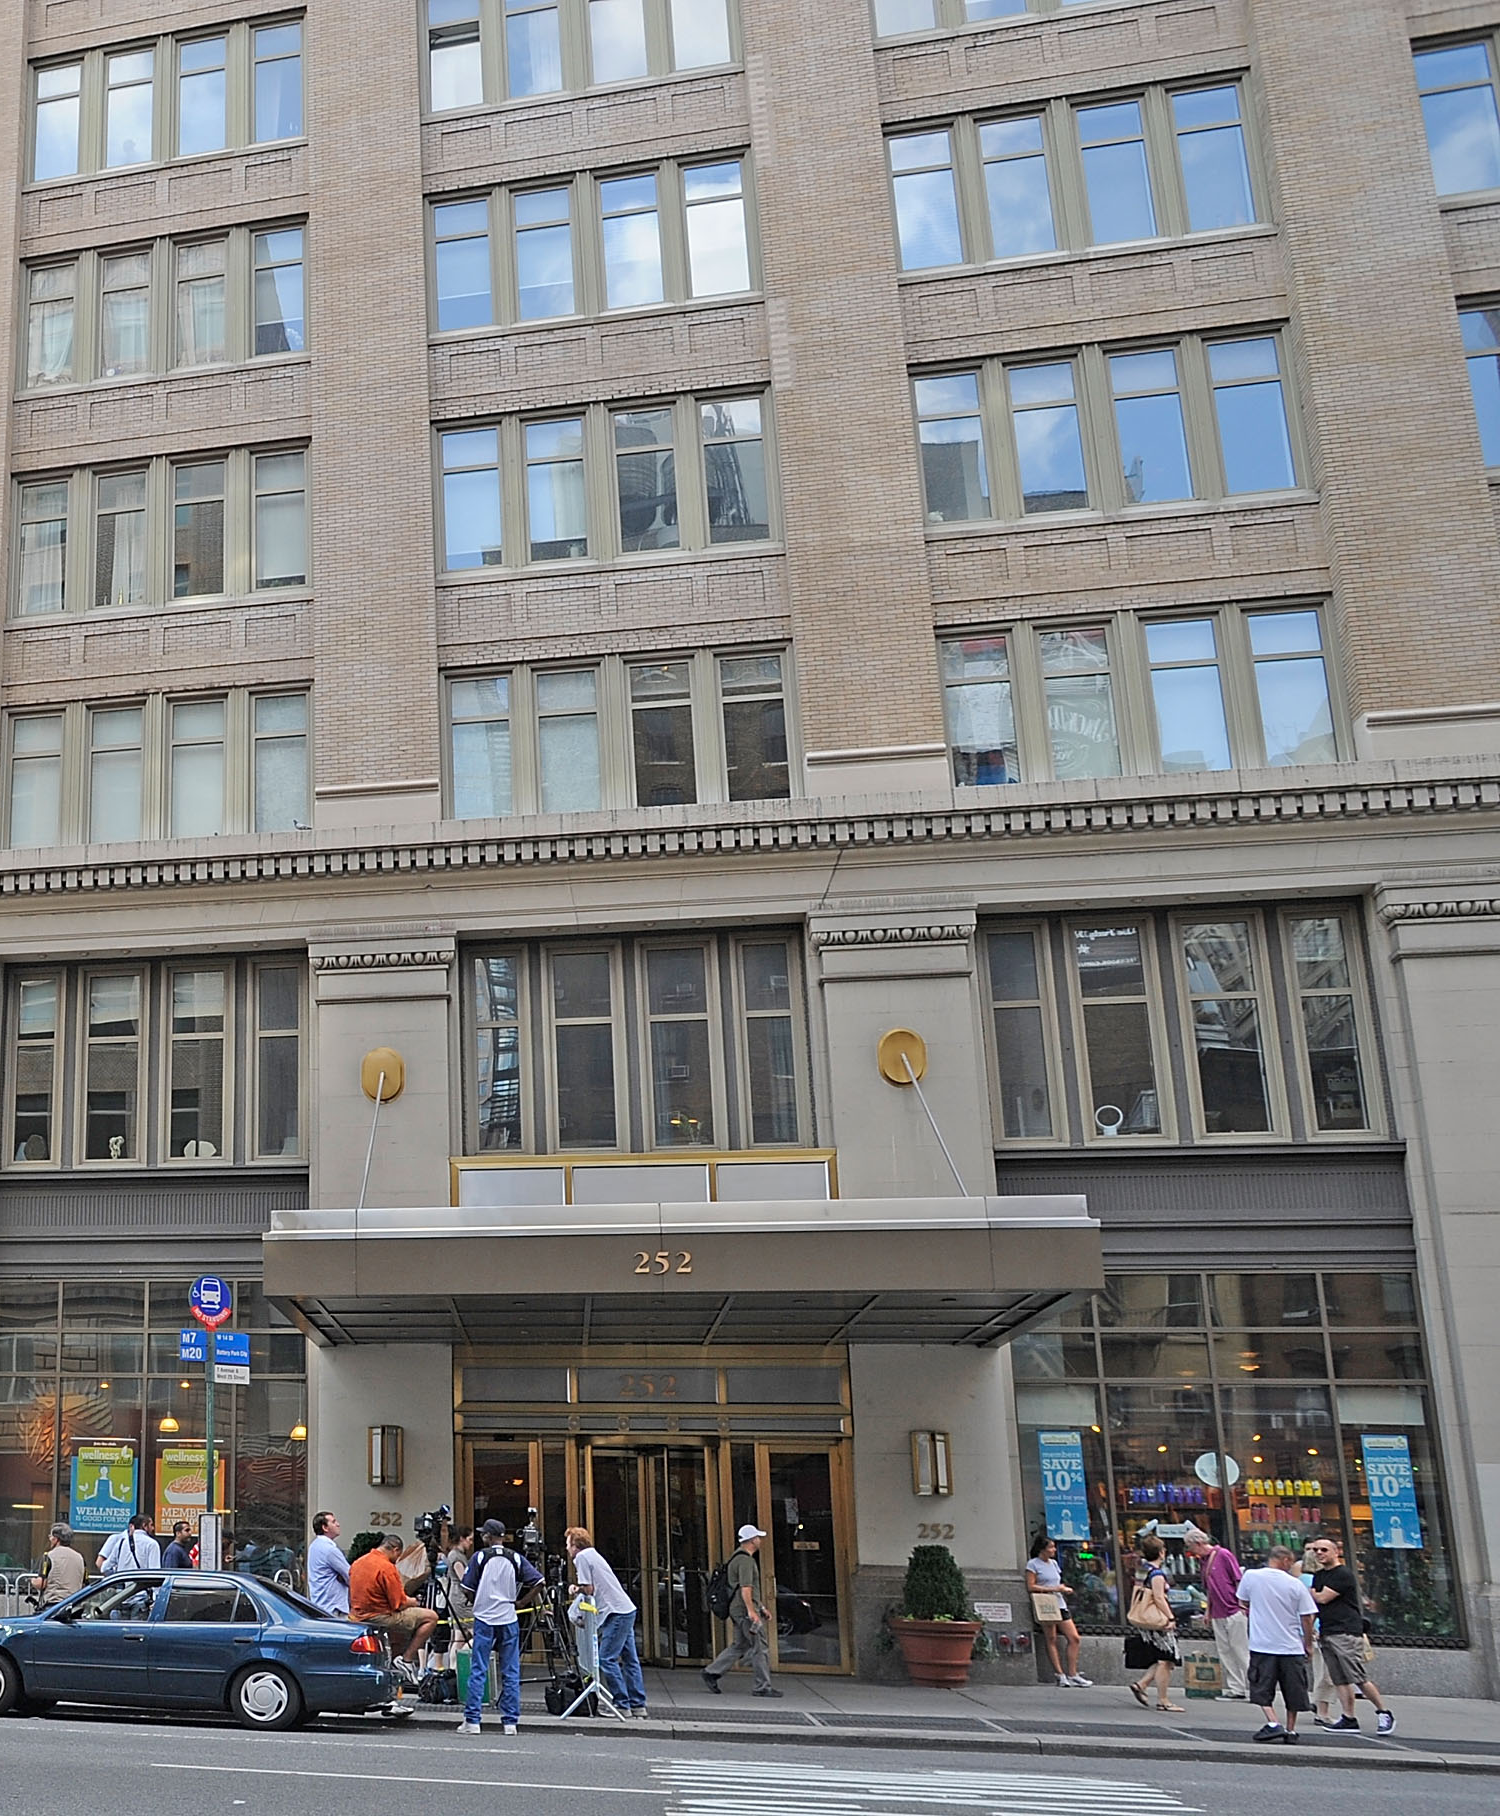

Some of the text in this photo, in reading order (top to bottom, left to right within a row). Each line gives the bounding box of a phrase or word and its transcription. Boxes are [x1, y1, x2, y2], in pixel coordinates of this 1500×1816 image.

[634, 1251, 693, 1275] 252
[193, 1308, 203, 1318] NO
[182, 1332, 197, 1344] M7
[181, 1348, 202, 1359] M20
[619, 1374, 677, 1397] 252
[82, 1449, 119, 1460] wellness
[165, 1452, 205, 1462] wellness
[1043, 1459, 1081, 1470] SAVE
[1367, 1463, 1411, 1475] SAVE
[1044, 1470, 1083, 1491] 10%
[1369, 1475, 1412, 1497] 10%
[76, 1506, 131, 1518] WELLNESS
[370, 1511, 402, 1527] 252
[918, 1523, 955, 1540] 252
